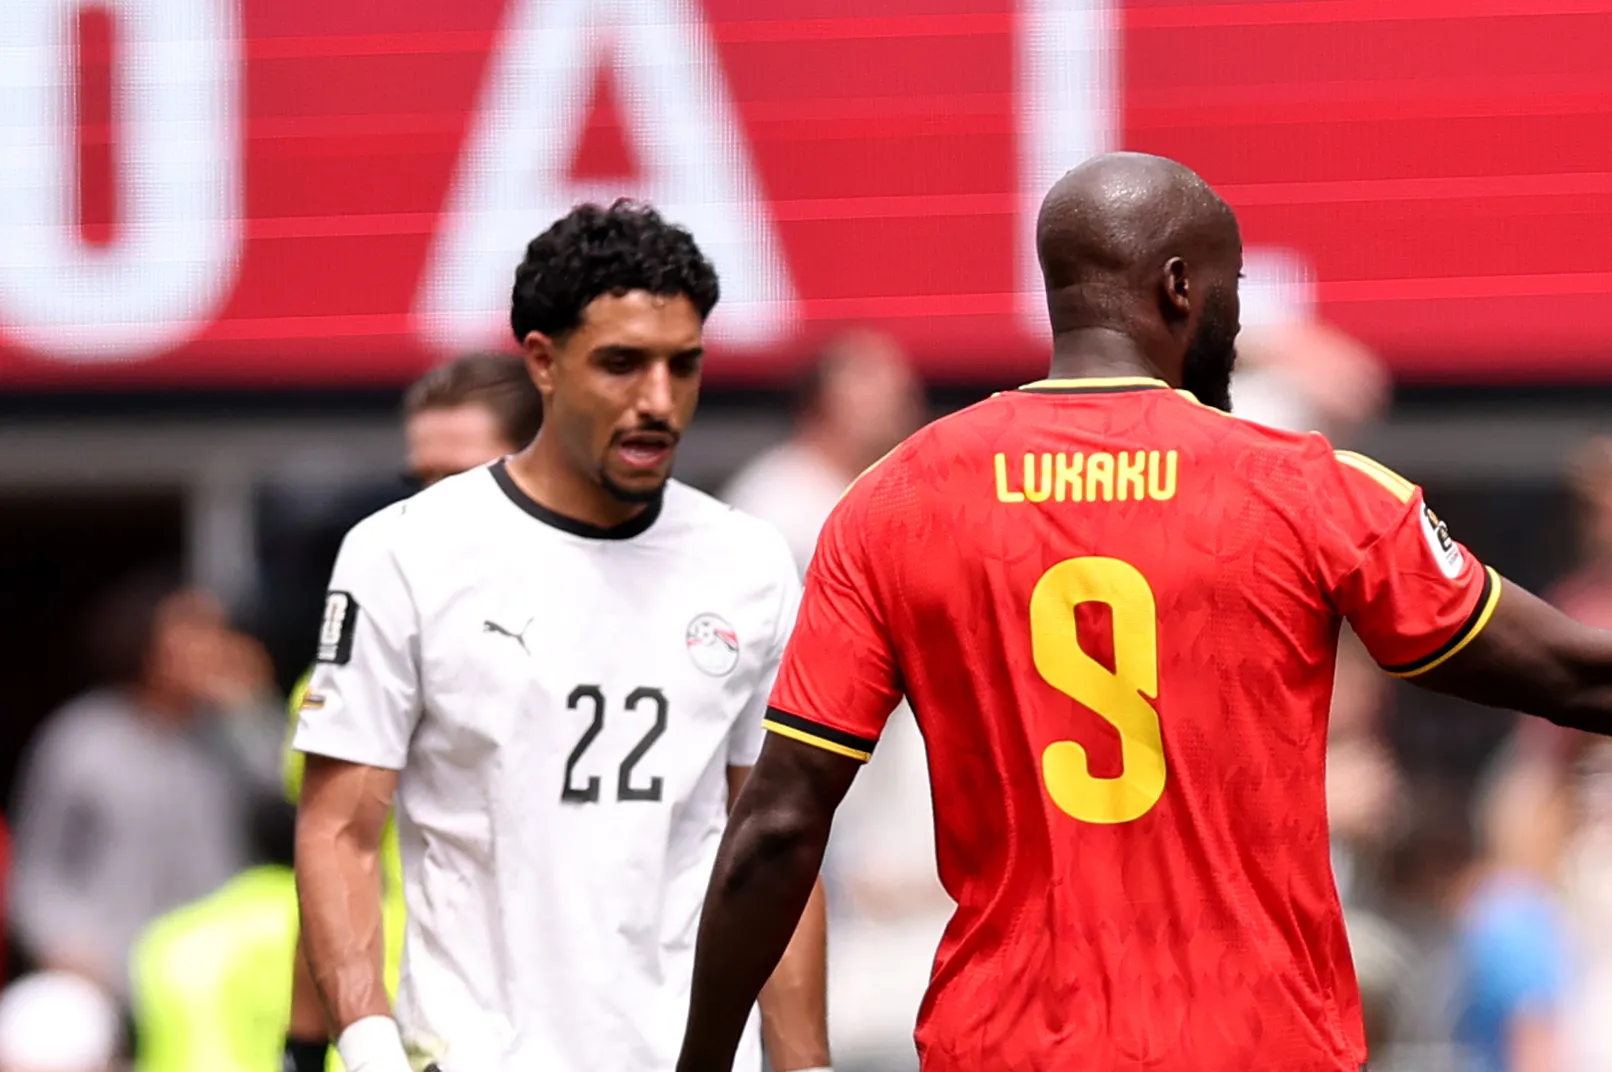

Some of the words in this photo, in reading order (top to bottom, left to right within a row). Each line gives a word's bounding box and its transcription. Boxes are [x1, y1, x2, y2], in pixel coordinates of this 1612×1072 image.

[994, 450, 1178, 502] LUKAKU
[560, 683, 670, 805] 22
[1030, 556, 1167, 824] 9
